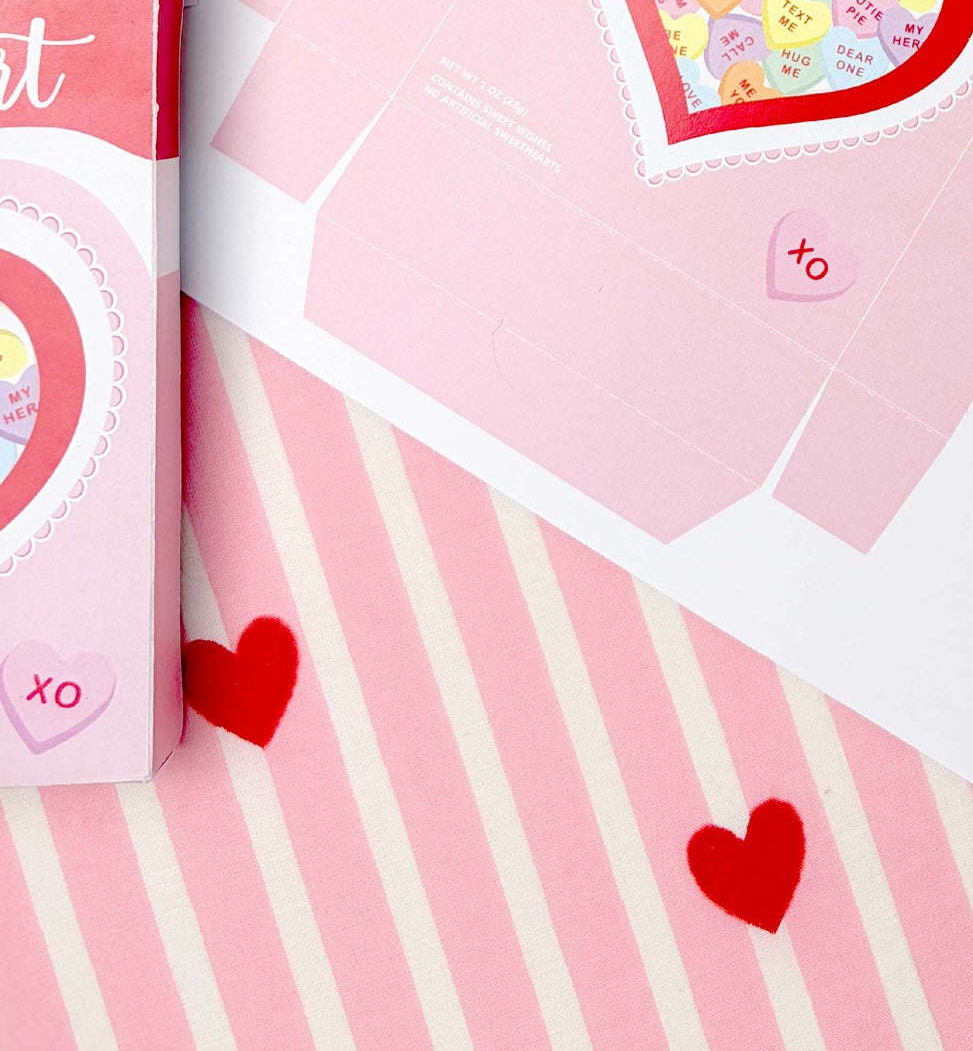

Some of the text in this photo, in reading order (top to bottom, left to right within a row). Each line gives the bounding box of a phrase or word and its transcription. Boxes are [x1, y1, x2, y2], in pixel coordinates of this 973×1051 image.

[778, 15, 798, 33] ME
[846, 5, 868, 26] PIE
[720, 30, 740, 47] ME
[905, 23, 925, 35] MY
[722, 36, 754, 61] CALL
[893, 35, 921, 49] HER
[781, 49, 811, 67] HUG
[836, 44, 874, 65] DEAR
[781, 64, 802, 78] ME
[836, 60, 865, 78] ONE
[440, 56, 528, 117] NET WT 1 OZ (28g)
[739, 79, 757, 98] ME
[730, 90, 745, 104] YO
[431, 73, 553, 153] CONTAINS SWEET WISHES
[424, 85, 562, 174] NO ARTIFICIAL SWEETHEARTS
[787, 238, 829, 280] XO
[8, 385, 32, 404] MY
[2, 402, 39, 425] HER
[26, 673, 82, 709] XO
